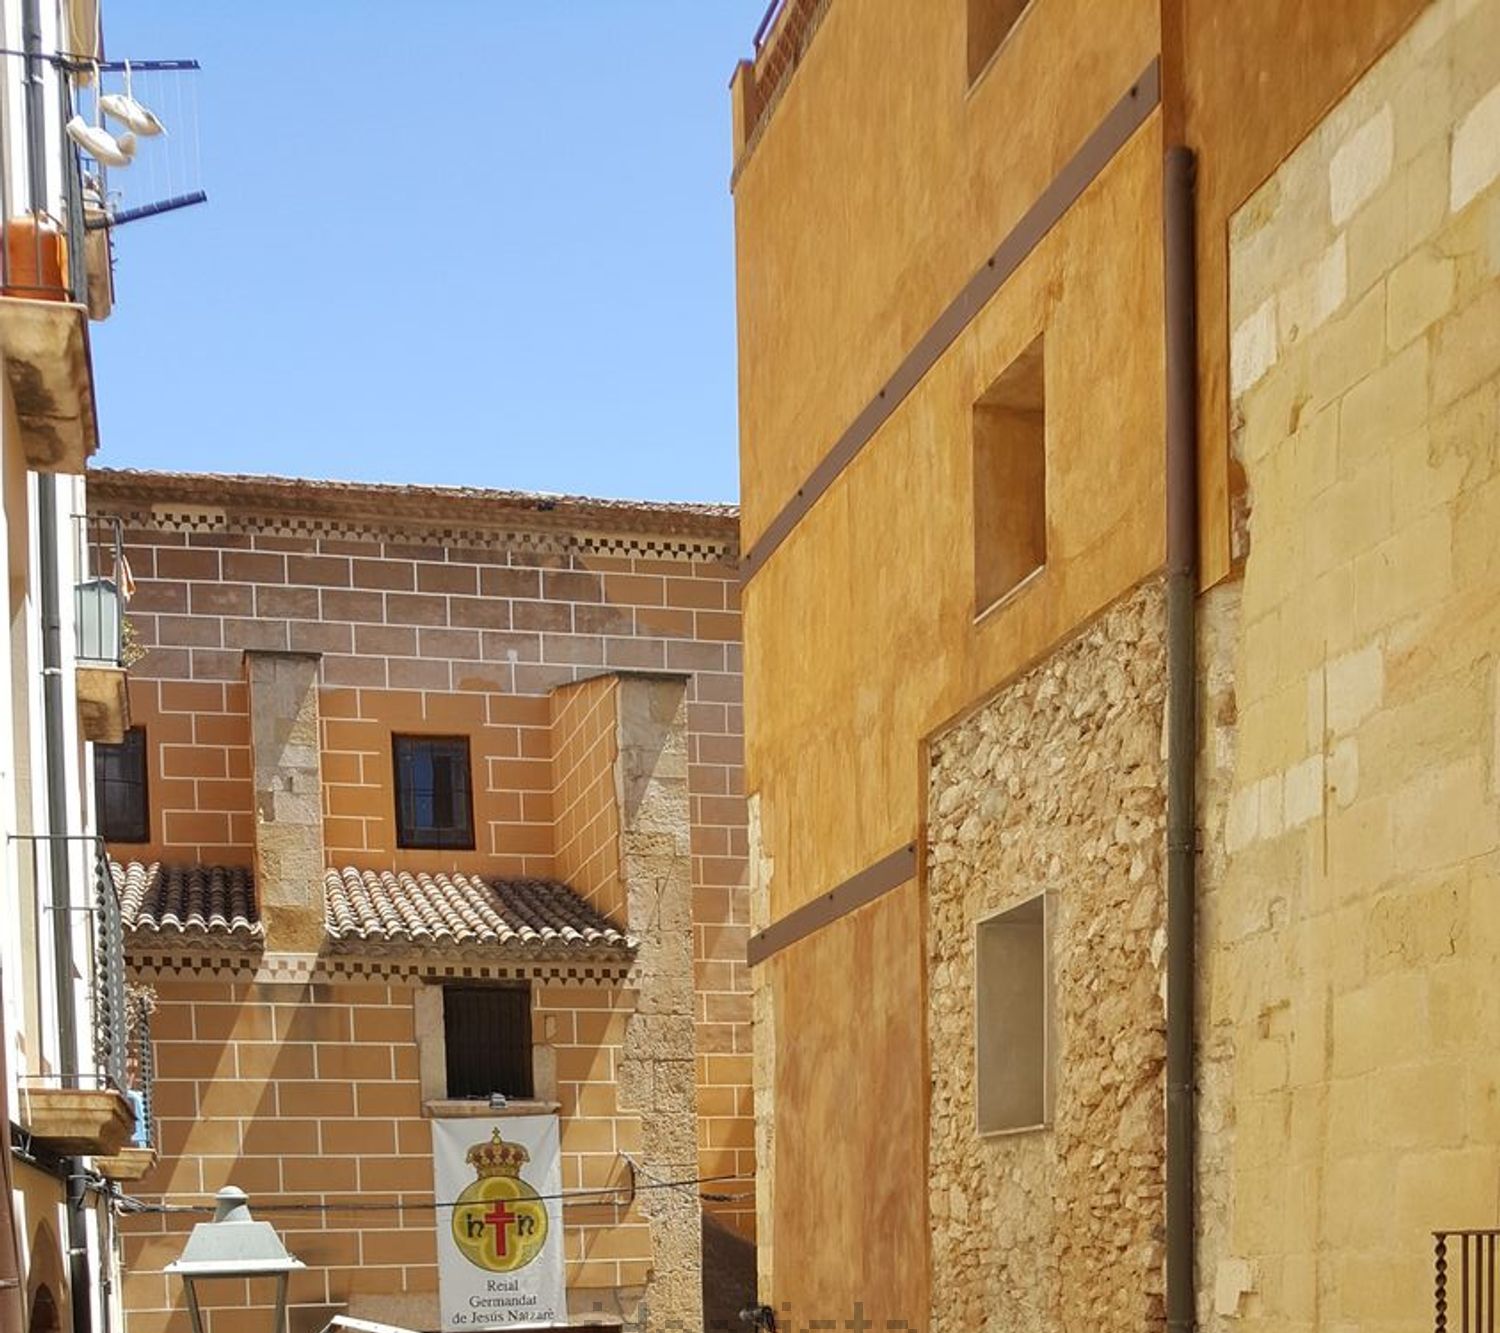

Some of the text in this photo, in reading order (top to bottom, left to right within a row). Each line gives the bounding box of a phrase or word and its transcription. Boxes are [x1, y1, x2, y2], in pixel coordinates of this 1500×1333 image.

[486, 1279, 519, 1292] Reial
[469, 1294, 537, 1308] Germandat
[451, 1312, 467, 1325] de
[471, 1310, 504, 1324] Jesús
